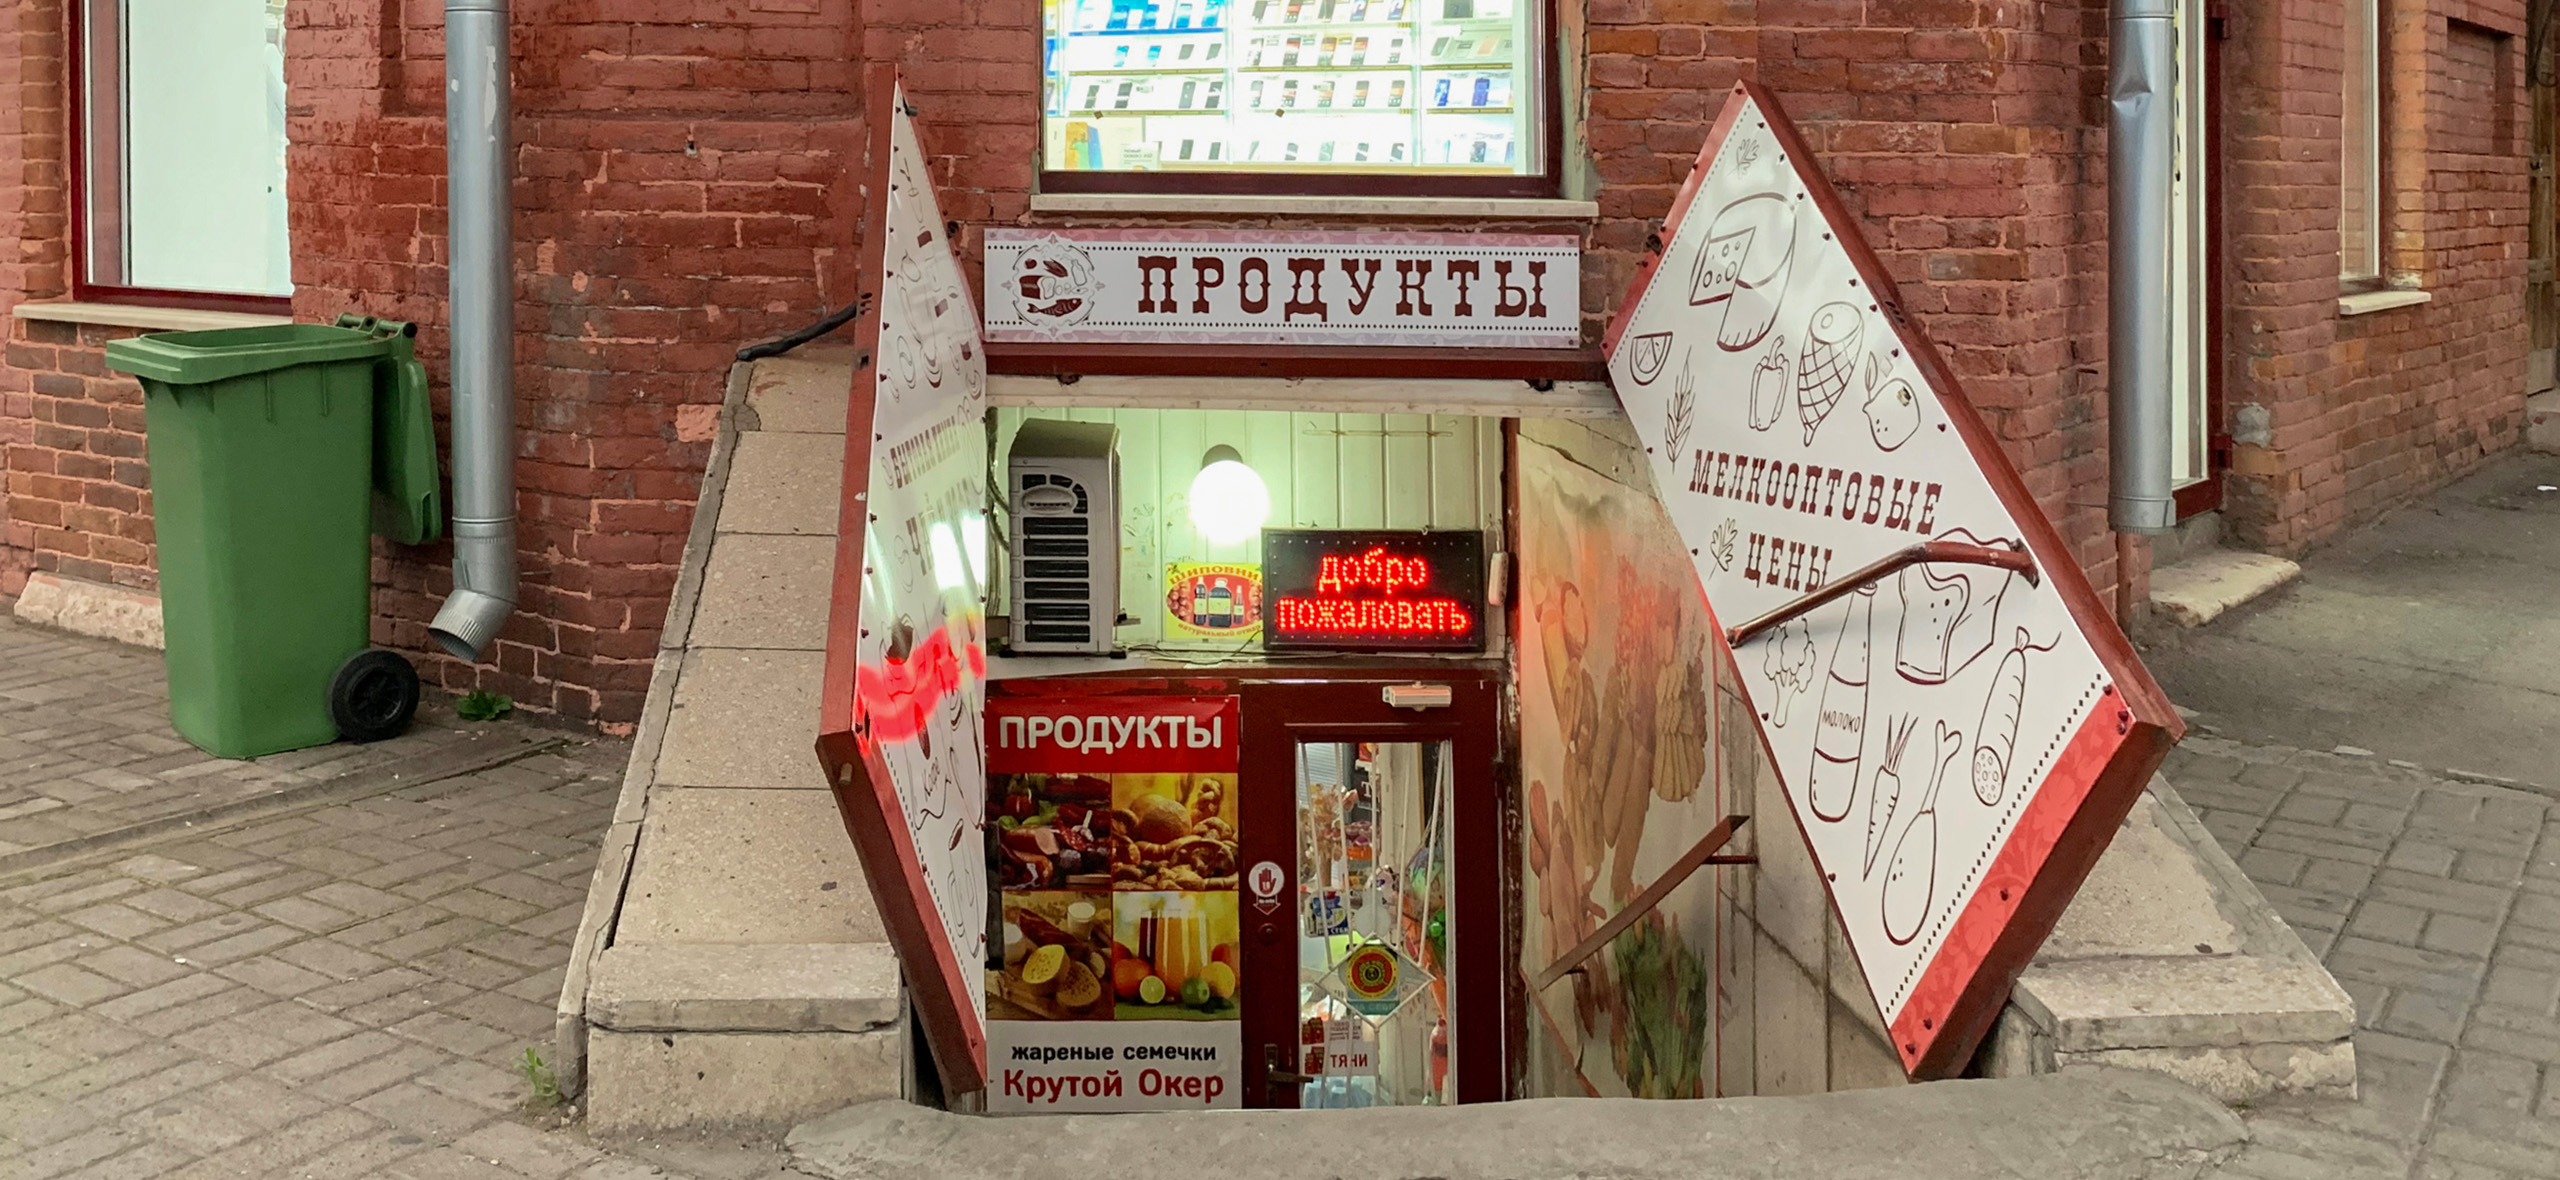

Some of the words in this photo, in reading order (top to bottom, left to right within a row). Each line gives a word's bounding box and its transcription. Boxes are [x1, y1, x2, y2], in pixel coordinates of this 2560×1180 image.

[1138, 255, 1547, 322] ПРОДУКТЫ
[1688, 448, 1943, 536] МЕЛКООПТОВЫЕ
[1169, 564, 1262, 585] ШИПОВНИ
[1318, 547, 1428, 596] добро
[1744, 531, 1834, 594] ЦЕНЫ
[1278, 599, 1470, 632] пожаловать
[999, 715, 1222, 755] ПРОДУКТЫ
[1011, 1045, 1115, 1065] жареные
[1122, 1045, 1217, 1061] семечки
[1003, 1068, 1123, 1105] Крутой
[1138, 1068, 1225, 1105] Окер
